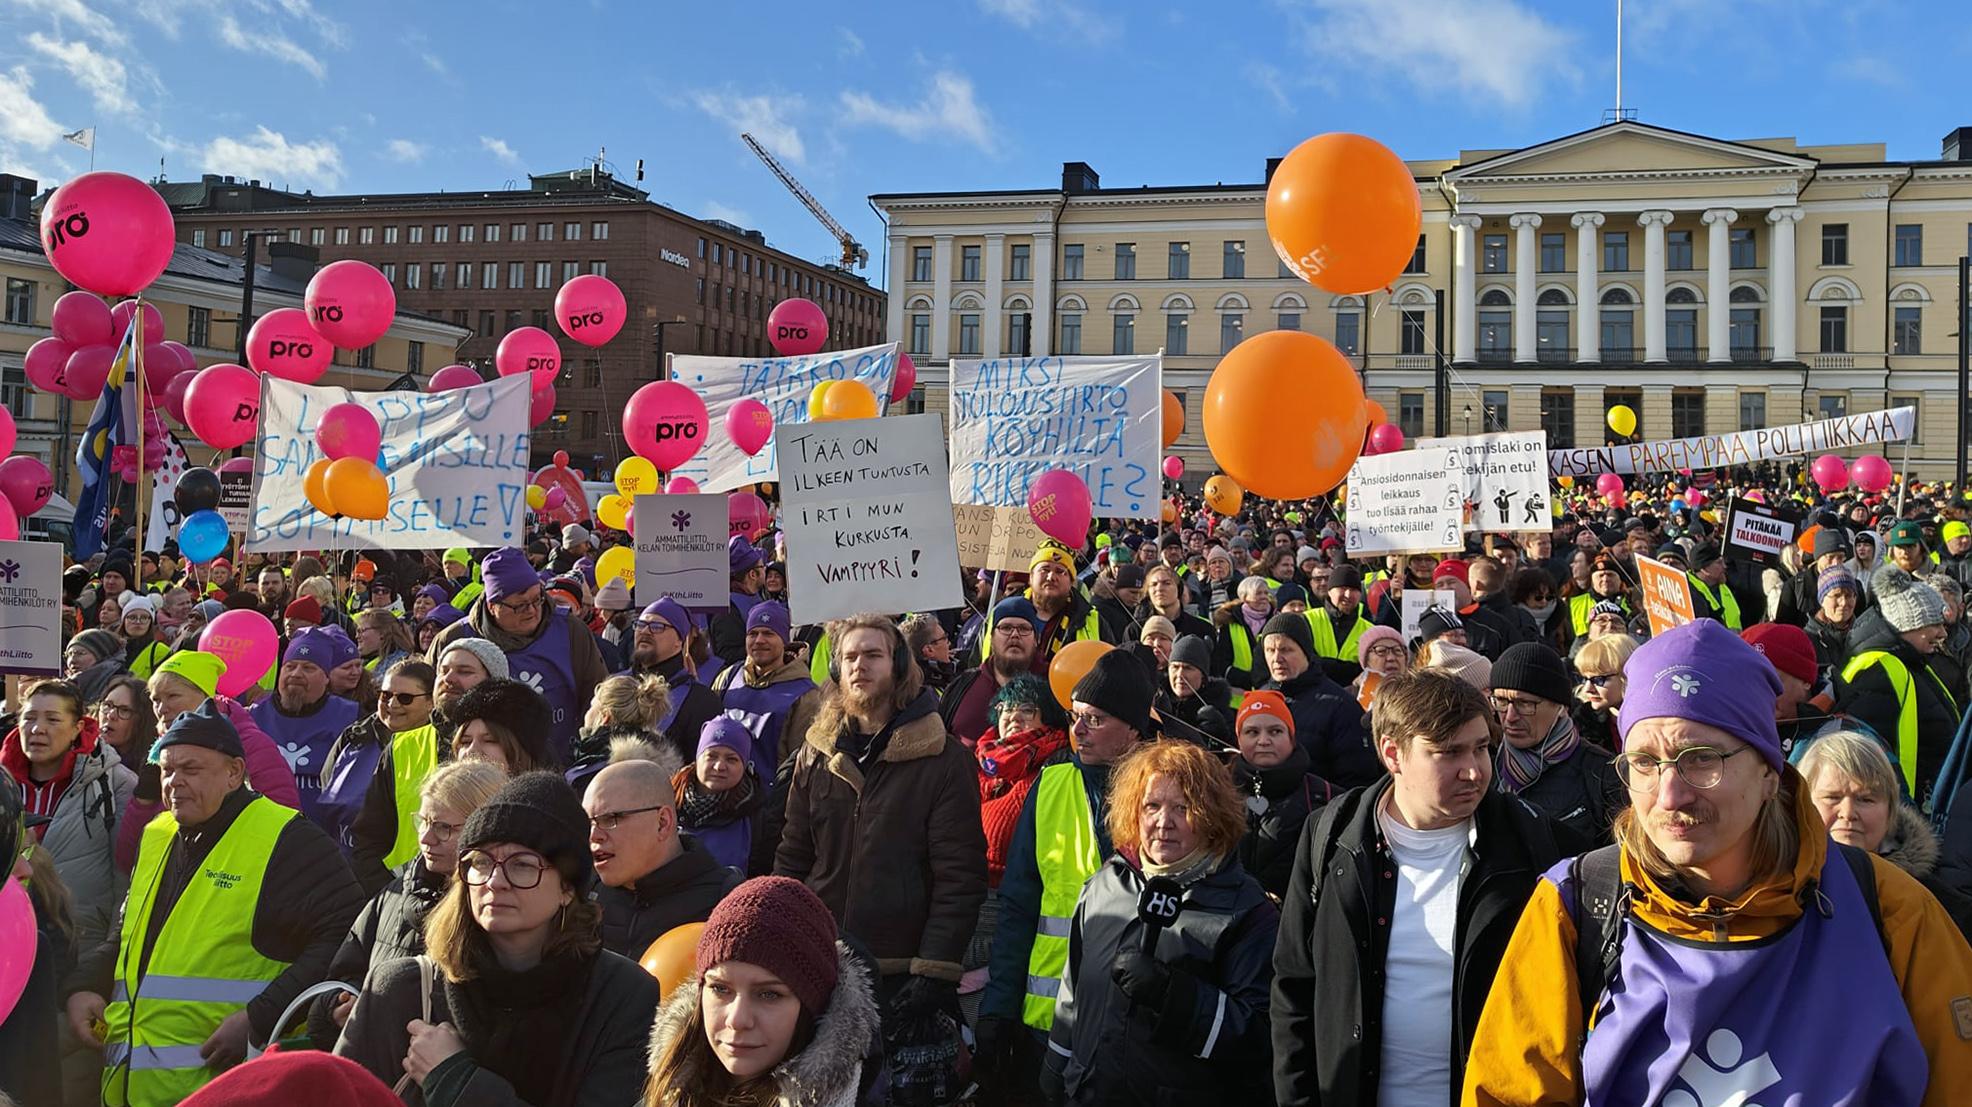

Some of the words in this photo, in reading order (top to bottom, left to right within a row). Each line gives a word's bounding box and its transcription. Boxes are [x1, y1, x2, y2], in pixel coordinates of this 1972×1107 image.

[661, 248, 690, 268] Nordea
[568, 311, 604, 331] pro
[777, 325, 808, 341] pro
[269, 340, 313, 359] pro
[527, 357, 556, 371] pro
[974, 358, 1063, 391] MIKSI
[232, 403, 259, 423] pr
[297, 386, 494, 438] LPPU
[656, 422, 698, 443] pro
[985, 411, 1129, 459] KÖYHILTÄ
[790, 434, 845, 463] TÄÄ
[852, 437, 878, 456] ON
[1462, 441, 1521, 455] omislaki
[1524, 442, 1542, 452] on
[1630, 435, 1750, 473] PAREMPAA
[1757, 410, 1898, 459] POLITIIKKAA
[858, 462, 930, 480] TUNTUSTA
[1360, 469, 1447, 486] Ansiosidonnaisen
[1462, 462, 1506, 477] ekijän
[1510, 461, 1536, 473] etu!
[35, 486, 53, 501] pr
[1380, 489, 1421, 501] leikkaus
[868, 502, 905, 517] MUN
[1032, 493, 1056, 513] STOP
[1366, 509, 1382, 518] tuo
[1384, 505, 1407, 516] lisää
[1408, 504, 1438, 515] rahaa
[956, 507, 998, 522] ANSA
[1009, 512, 1036, 525] KUO
[957, 524, 981, 536] UN
[1368, 521, 1434, 537] työntekijälle!
[1745, 518, 1782, 537] PITÄKÄÄ
[637, 543, 660, 552] KELAN
[661, 542, 714, 552] TOIMIHENKILÖT
[716, 543, 726, 552] RY
[655, 534, 708, 544] AMMATTILIITTO
[959, 541, 1006, 556] SISTEJA
[47, 599, 57, 608] RY
[1146, 891, 1178, 917] HS
